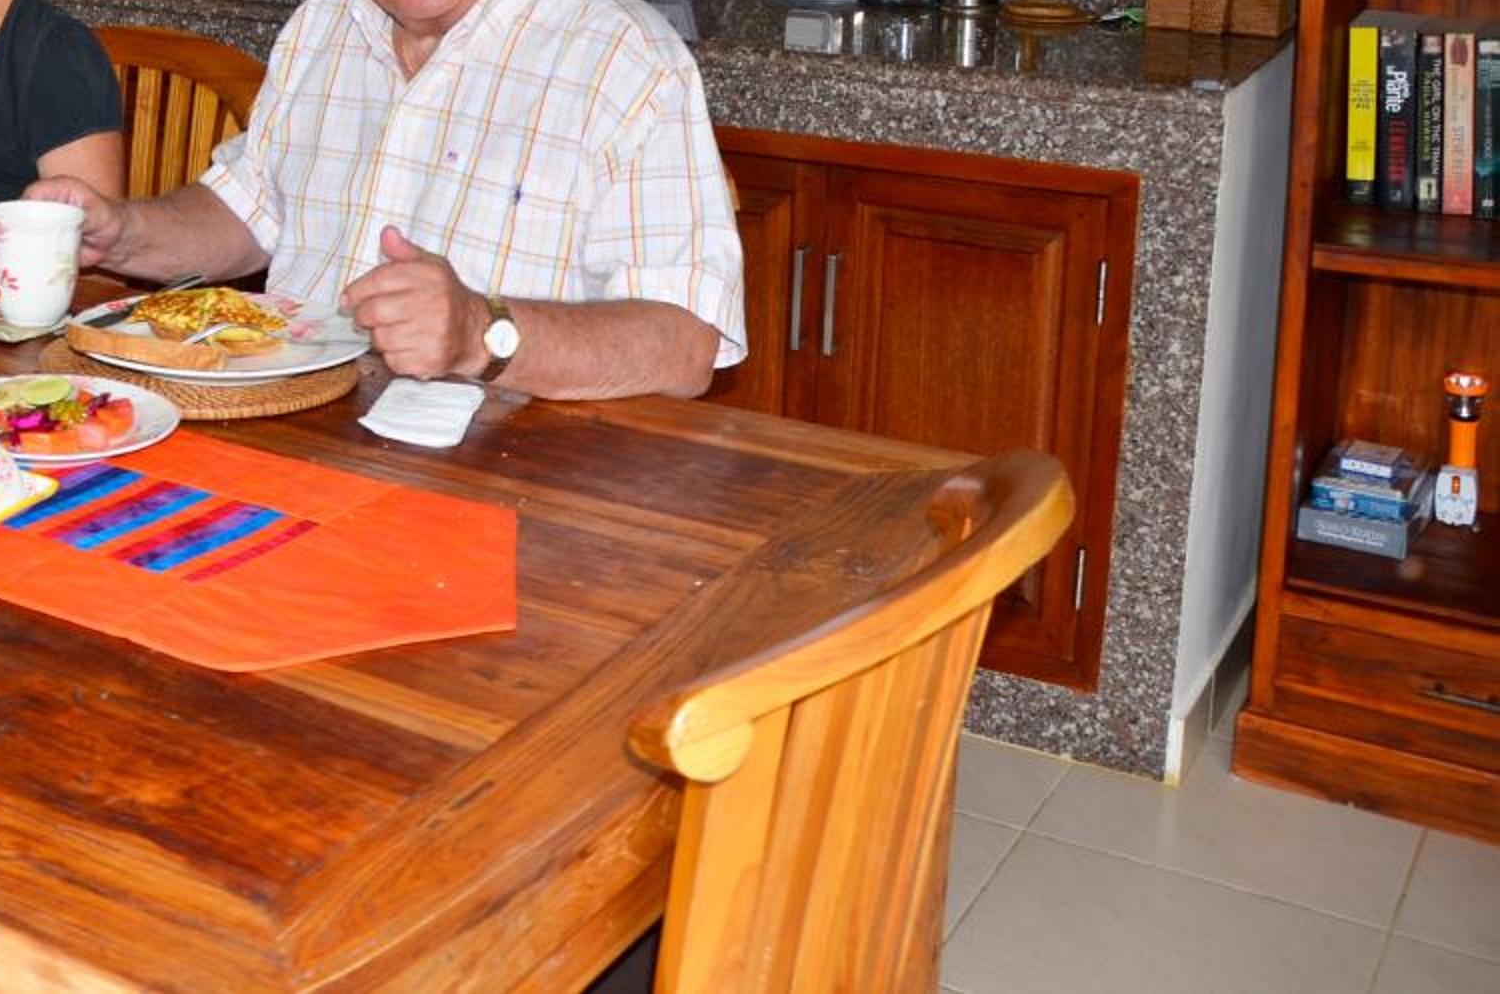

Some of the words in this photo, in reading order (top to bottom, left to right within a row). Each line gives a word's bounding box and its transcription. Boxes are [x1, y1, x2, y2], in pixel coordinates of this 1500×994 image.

[1432, 58, 1442, 76] THE
[1385, 68, 1406, 113] Plante
[1432, 79, 1442, 103] GIRL
[1432, 105, 1442, 121] ON
[1432, 124, 1441, 143] THE
[1431, 146, 1441, 174] TRAIN
